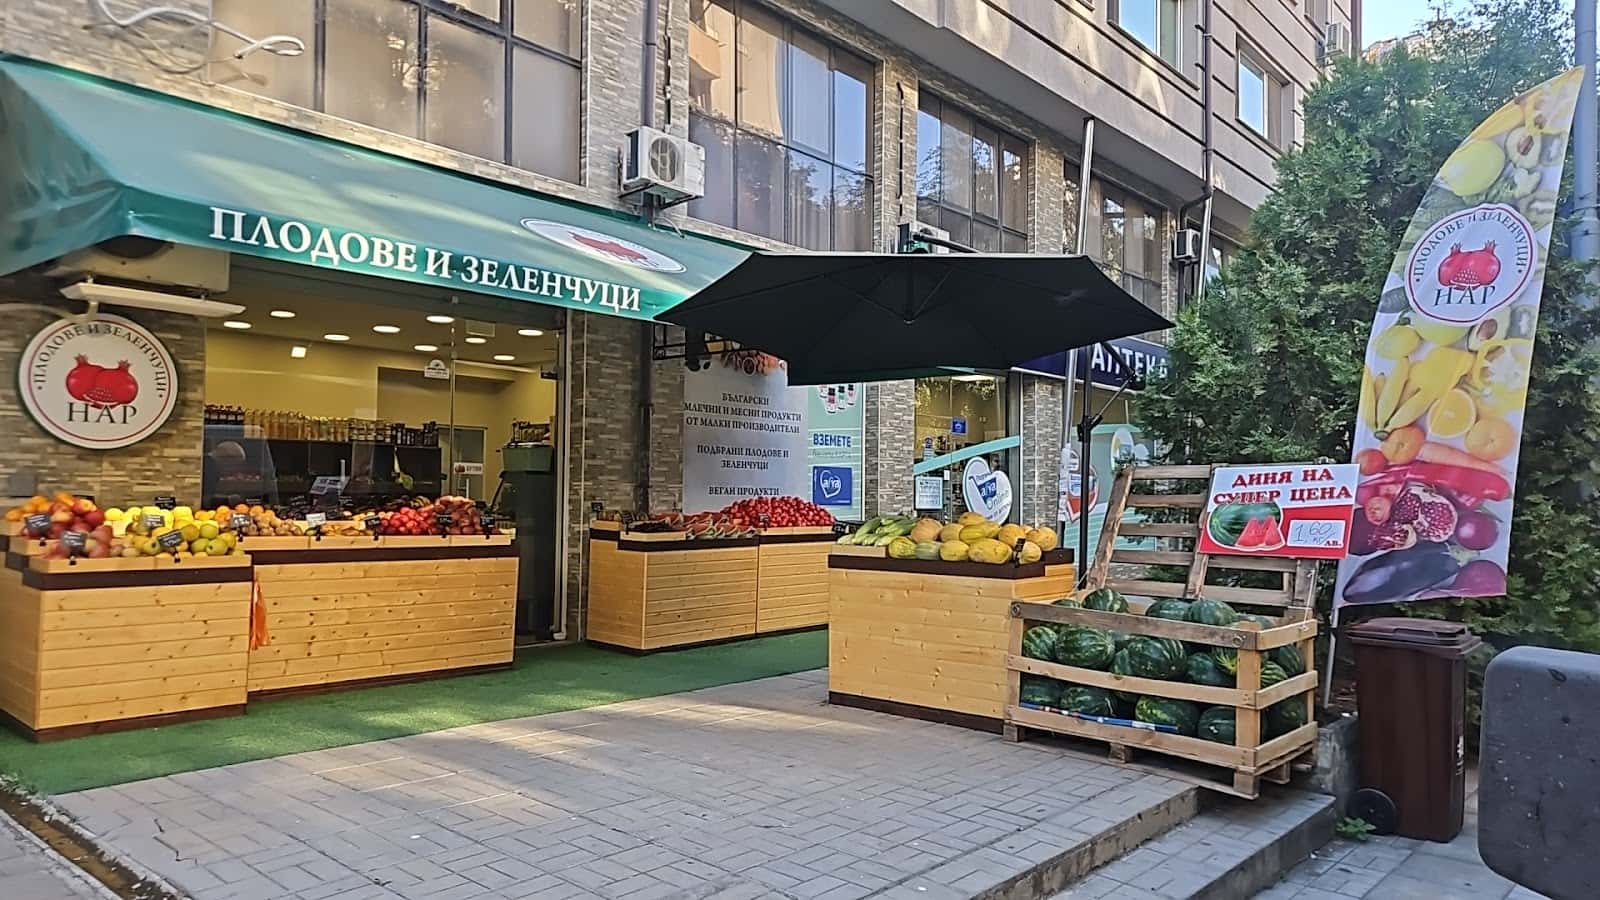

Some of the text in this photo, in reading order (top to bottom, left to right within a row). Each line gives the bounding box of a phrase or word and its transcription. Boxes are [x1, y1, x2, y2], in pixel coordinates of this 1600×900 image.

[1414, 218, 1465, 276] ПЛОДОВЕ
[209, 206, 641, 313] ПЛОДОВЕ И ЗЕЛЕНЧУЦИ
[1434, 285, 1496, 306] НАР
[34, 324, 168, 392] ПЛОДОВЕ И ЗЕЛЕНЧУЦИ
[721, 393, 769, 406] БЪЛГАРСКИ
[67, 402, 137, 424] НАР
[684, 402, 802, 422] МЛЕЧНИ И МЕСНИ ПРОДУКТИ
[686, 416, 800, 433] ОТ МАЛКИ ПРОИЗВОДИТЕЛИ
[813, 433, 851, 448] ВЗЕМЕТЕ
[697, 444, 789, 458] ПОДБРАНИ ПЛОДОВЕ И
[721, 459, 768, 470] ЗЕЛЕНЧУЦИ
[1232, 468, 1334, 488] ДИНЯ НА
[709, 486, 779, 496] ВЕГАН ПРОДУКТИ
[1213, 486, 1353, 504] СУПЕР ЦЕНА
